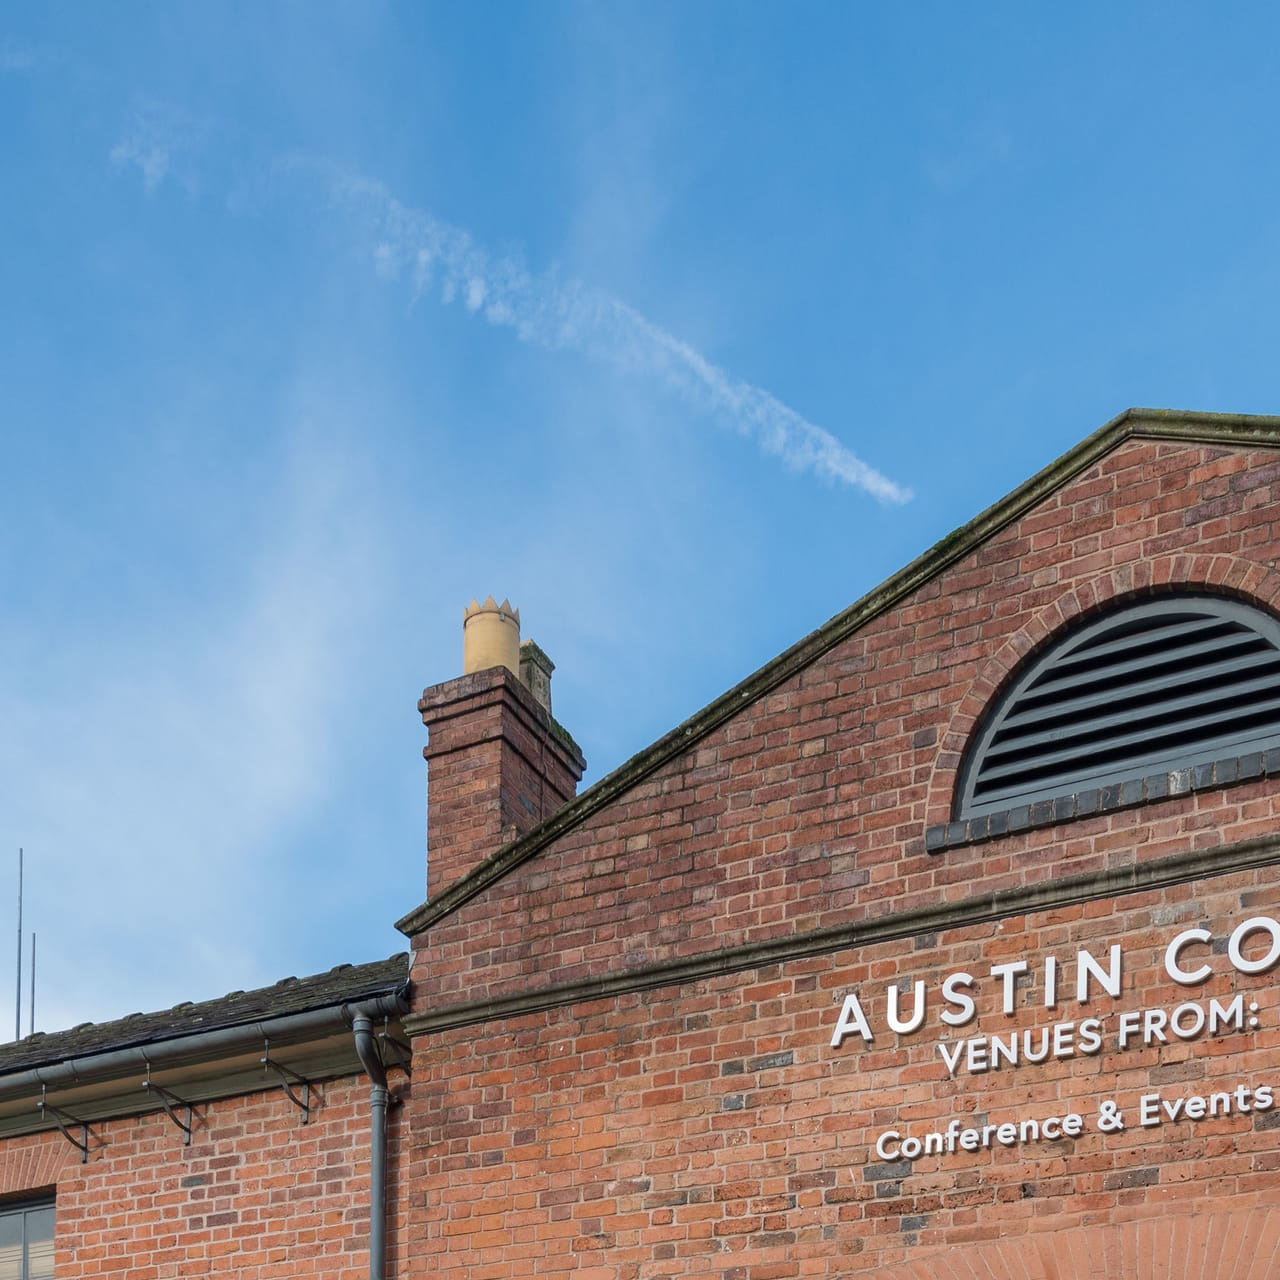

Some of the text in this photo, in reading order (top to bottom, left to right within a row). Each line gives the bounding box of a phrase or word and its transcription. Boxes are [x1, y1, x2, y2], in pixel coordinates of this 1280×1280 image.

[830, 944, 1122, 1047] AUSTIN
[938, 1018, 1103, 1074] VENUES
[1119, 994, 1260, 1048] FROM:
[875, 1112, 1083, 1160] Conference
[1096, 1100, 1124, 1132] &
[1140, 1084, 1274, 1127] Events
